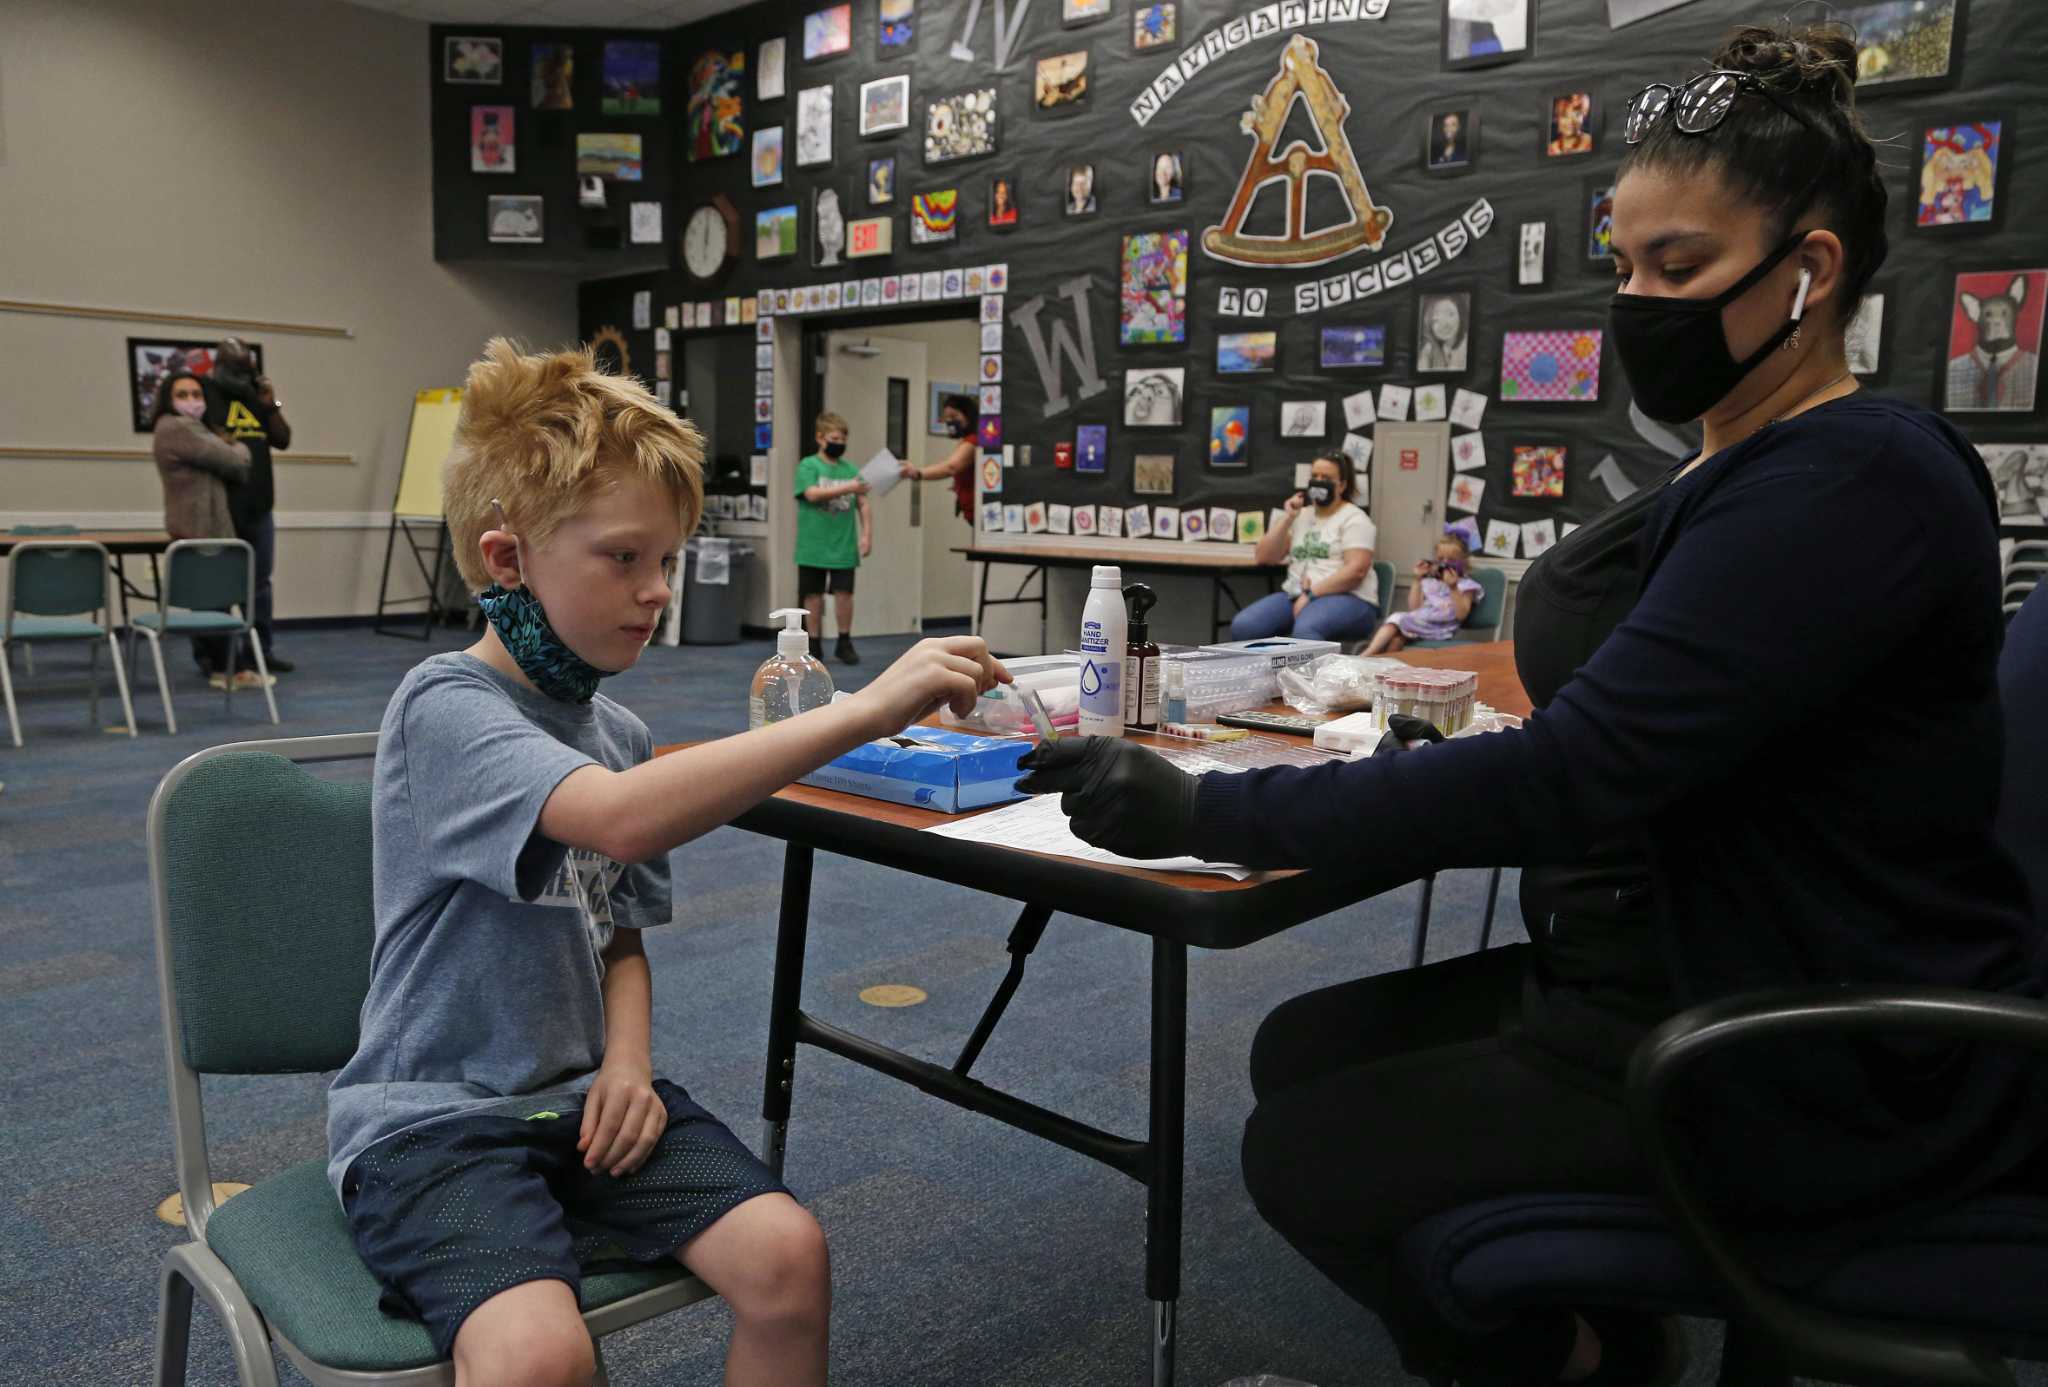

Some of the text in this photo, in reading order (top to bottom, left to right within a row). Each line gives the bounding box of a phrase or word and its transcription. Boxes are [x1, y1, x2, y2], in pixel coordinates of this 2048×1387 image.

[1133, 0, 1386, 121] NAVIGATING
[853, 223, 880, 252] EXIT
[1222, 200, 1493, 311] TO SUCCESS
[1081, 637, 1109, 646] ANITIZER
